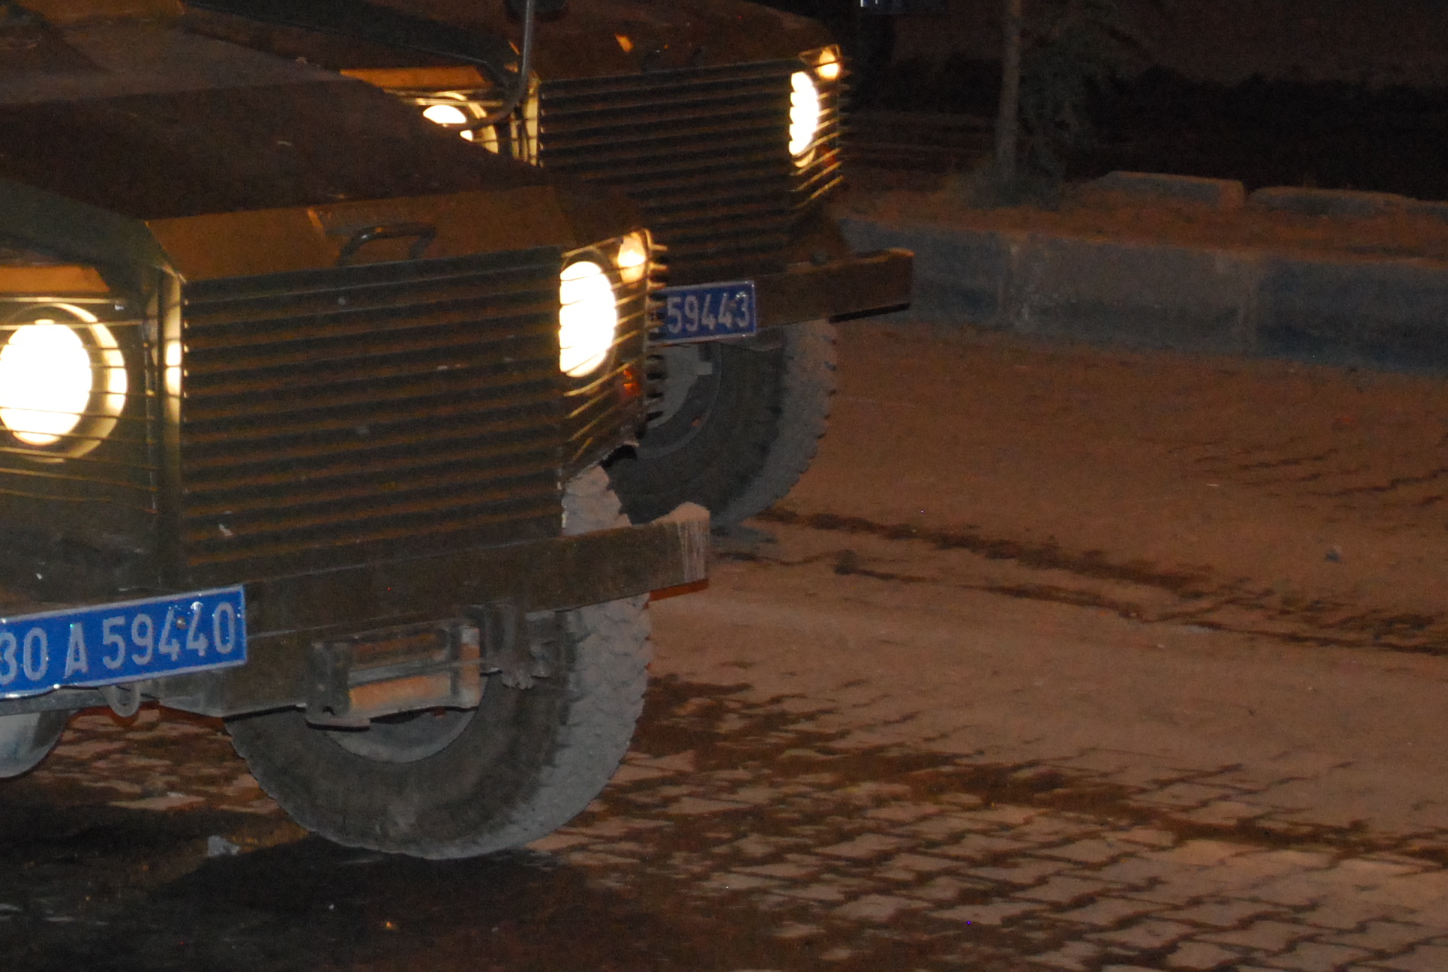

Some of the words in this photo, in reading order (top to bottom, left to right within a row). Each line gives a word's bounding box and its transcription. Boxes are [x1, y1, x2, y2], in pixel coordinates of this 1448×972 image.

[666, 290, 751, 334] 59443
[64, 622, 89, 679] A
[102, 602, 236, 671] 59440
